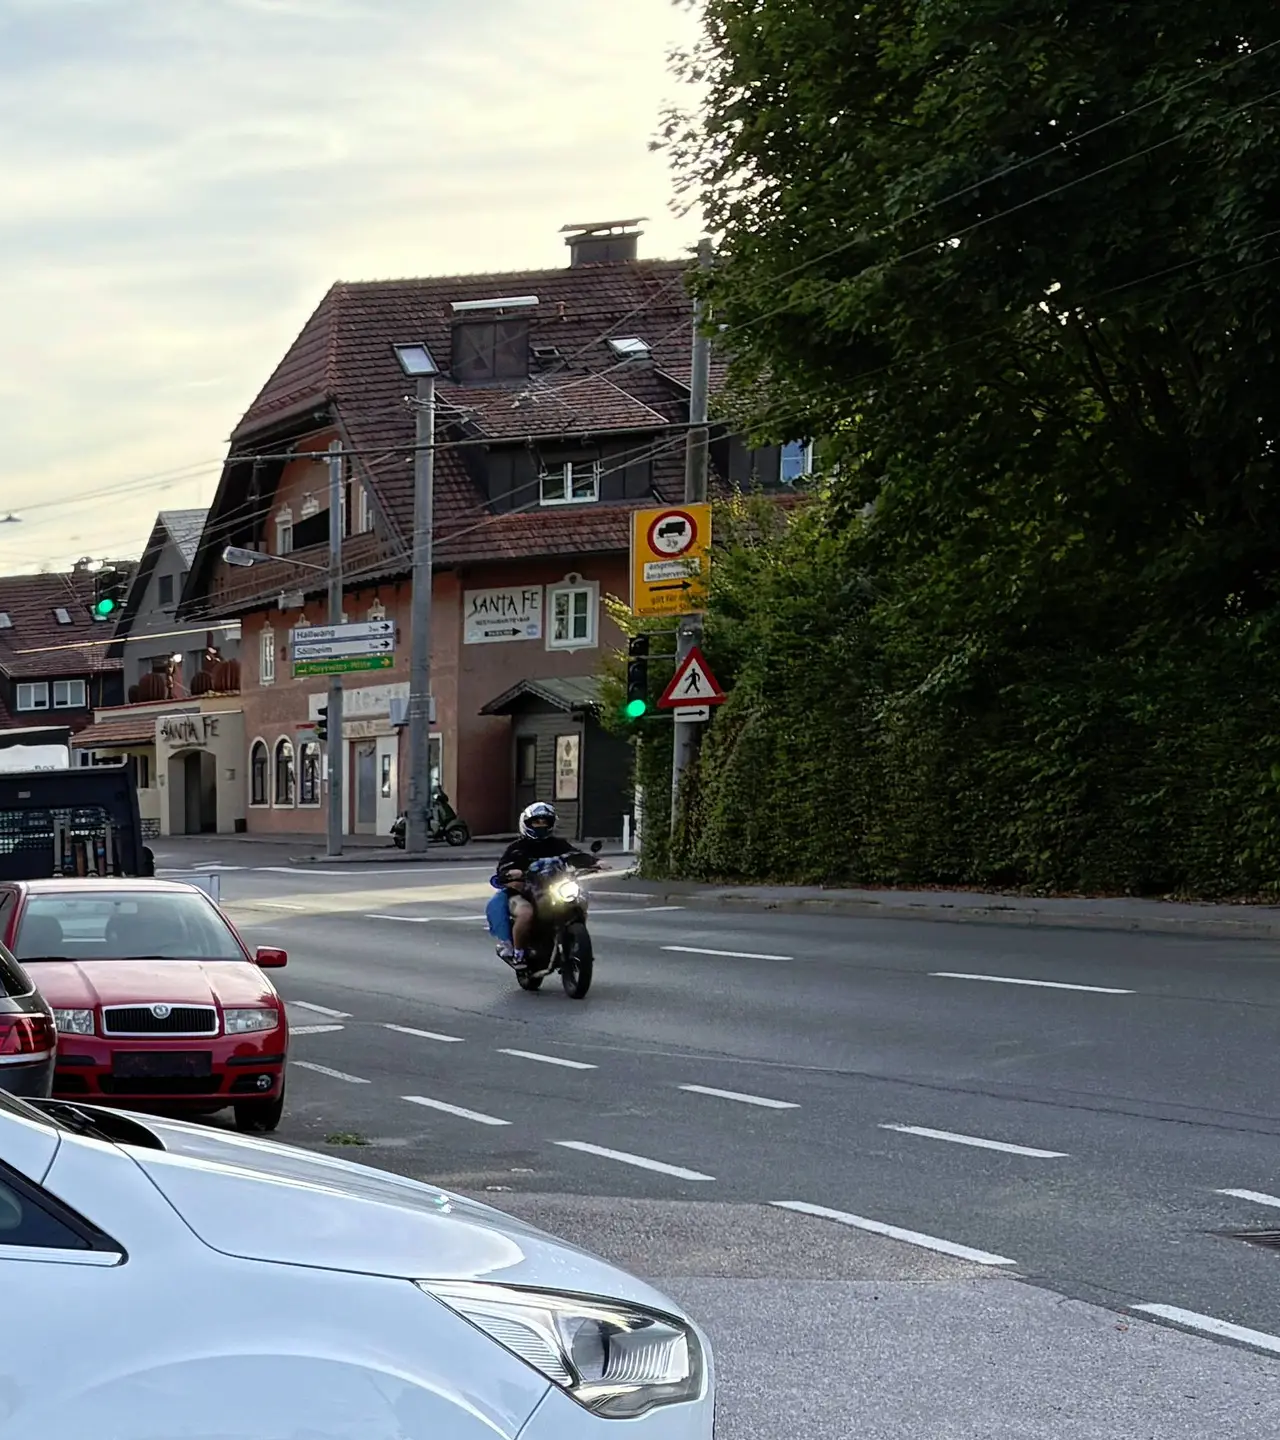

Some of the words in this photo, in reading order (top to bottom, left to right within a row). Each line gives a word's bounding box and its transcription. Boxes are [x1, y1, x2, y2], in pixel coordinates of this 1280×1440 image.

[467, 593, 518, 618] SANTA
[522, 589, 538, 615] FE
[297, 630, 336, 639] Hallwang
[297, 645, 333, 656] Söllheim
[202, 715, 220, 740] FE
